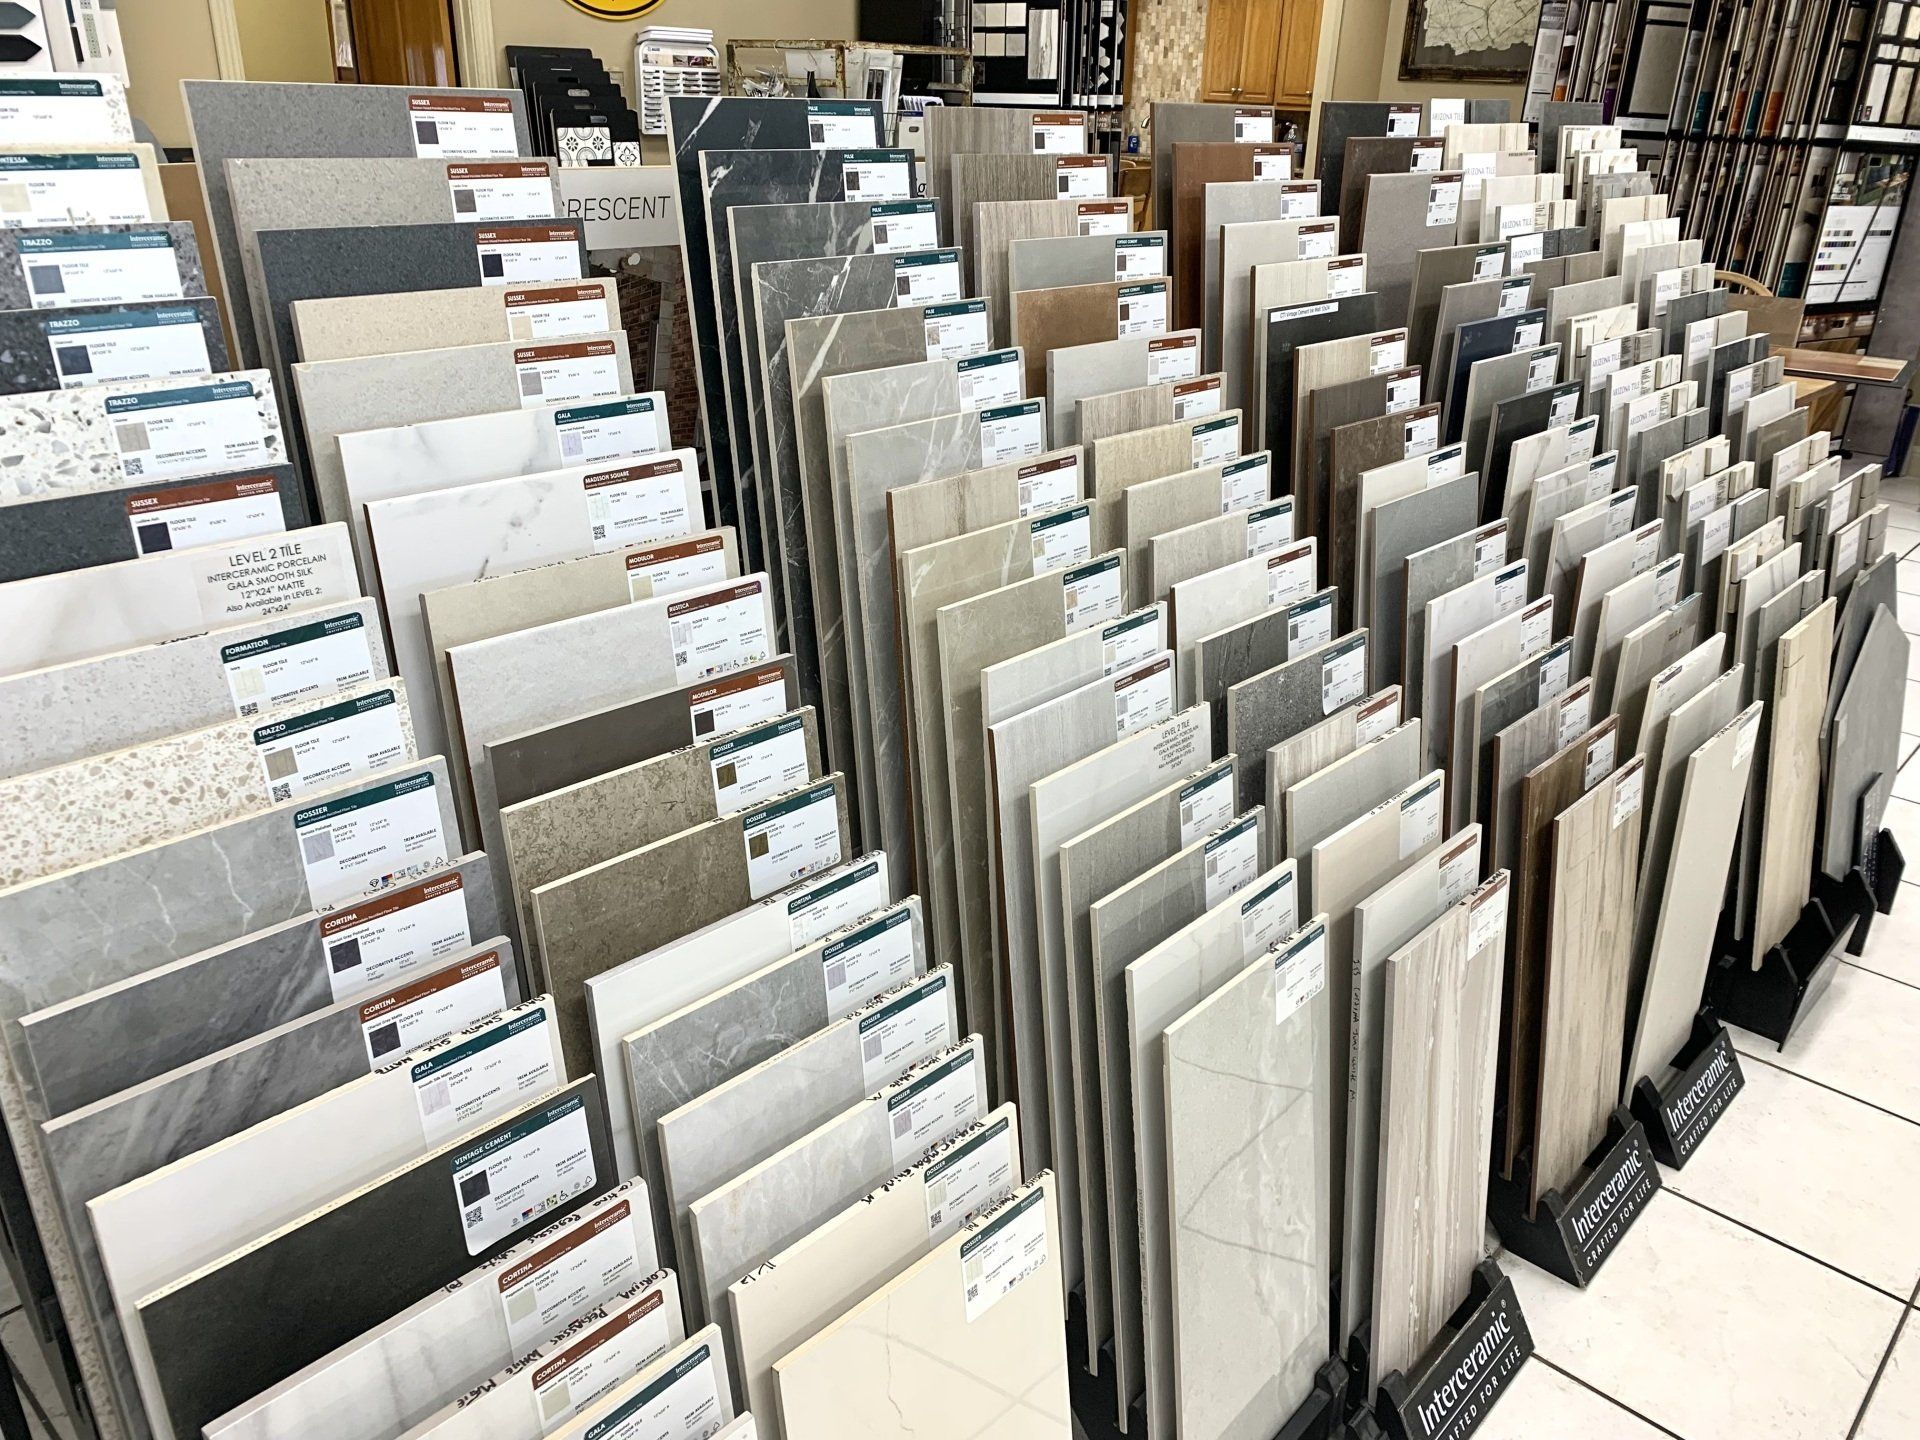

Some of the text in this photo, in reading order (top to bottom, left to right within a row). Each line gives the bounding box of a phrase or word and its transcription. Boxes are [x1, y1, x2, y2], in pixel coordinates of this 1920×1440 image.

[562, 196, 671, 222] RESCENT
[130, 234, 167, 242] Interceramic
[157, 310, 195, 319] Interceramic
[49, 320, 79, 328] TRAZZO
[213, 385, 248, 395] Interceramic
[108, 398, 138, 407] TRAZZO
[654, 463, 677, 471] Interceramic
[236, 479, 272, 492] Interceramic
[585, 471, 630, 484] MADISON SQUARE
[131, 497, 158, 508] SUSSEX
[229, 543, 301, 567] LEVEL 2 TILE
[629, 554, 654, 564] MODULOR
[207, 554, 326, 583] INTERCERAMIC PORCELAIN
[227, 567, 313, 591] GALA SMOOTH SILK
[278, 580, 305, 592] MATTE
[226, 602, 242, 613] Also
[244, 594, 282, 608] Available
[284, 592, 290, 601] in
[291, 588, 314, 600] LEVEL
[324, 615, 359, 630] Interceramic
[225, 639, 269, 656] FORMATION
[271, 684, 318, 701] DECORATIVE ACCENTS
[356, 691, 391, 707] Interceramic
[692, 688, 717, 699] MODULOR
[258, 724, 286, 737] TRAZZO
[1162, 727, 1176, 739] LEVEL
[1181, 720, 1190, 729] TILE
[713, 742, 734, 754] DOSSIER
[303, 763, 350, 781] DECORATIVE ACCENTS
[394, 774, 429, 790] Interceramic
[297, 806, 328, 820] DOSSIER
[746, 812, 767, 824] DOSSIER
[339, 845, 387, 864] DECORATIVE ACCENTS
[423, 877, 458, 894] Interceramic
[790, 894, 812, 908] CORTINA
[324, 913, 358, 929] CORTINA
[360, 932, 374, 940] FLOOR
[825, 942, 844, 956] DOSSIER
[365, 951, 414, 972] DECORATIVE ACCENTS
[461, 955, 496, 974] Interceramic
[364, 997, 396, 1015] CORTINA
[399, 1014, 413, 1023] FLOOR
[508, 1011, 542, 1031] Interceramic
[861, 1013, 880, 1027] DOSSIER
[414, 1062, 433, 1074] GALA
[448, 1067, 473, 1081] FLOOR TILE
[891, 1089, 910, 1105] DOSSIER
[1666, 1048, 1729, 1133] Interceramic
[455, 1087, 500, 1112] DECORATIVE ACCENTS
[547, 1096, 581, 1117] Interceramic
[1680, 1078, 1738, 1155] CRAFTED FOR LIFE
[454, 1132, 512, 1165] VINTAGE CEMENT
[488, 1156, 512, 1170] FLOOR TILE
[926, 1161, 946, 1176] DOSSIER
[495, 1175, 539, 1200] DECORATIVE ACCENTS
[1572, 1148, 1642, 1243] Interceramic
[594, 1207, 626, 1228] Interceramic
[1587, 1178, 1651, 1266] CRAFTED FOR LIFE
[963, 1234, 982, 1251] DOSSIER
[502, 1262, 533, 1284] CORTINA
[541, 1286, 586, 1316] DECORATIVE ACCENTS
[627, 1295, 660, 1319] Interceramic
[676, 1347, 706, 1373] Interceramic
[536, 1357, 567, 1381] CORTINA
[1418, 1311, 1510, 1436] Interceramic
[1449, 1345, 1520, 1440] AFTED FOR LIFE
[588, 1424, 605, 1439] GALA
